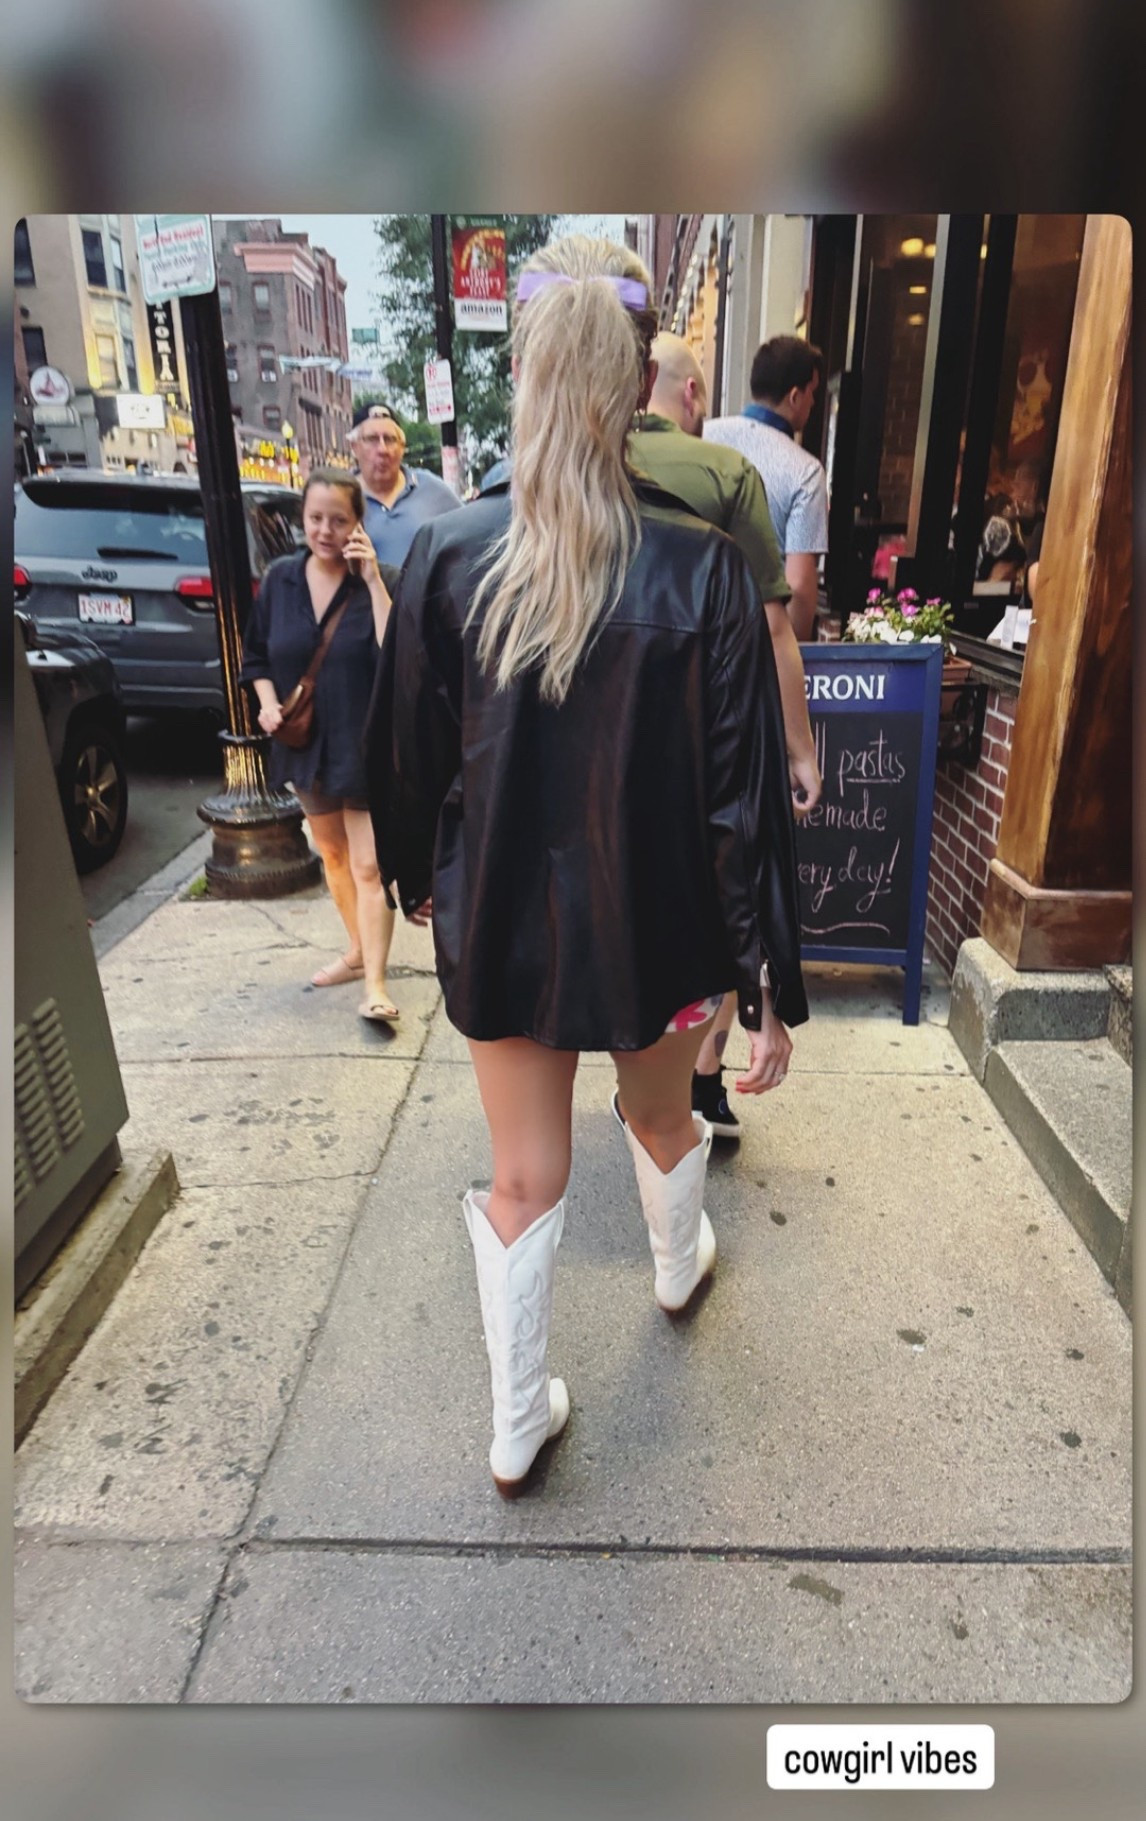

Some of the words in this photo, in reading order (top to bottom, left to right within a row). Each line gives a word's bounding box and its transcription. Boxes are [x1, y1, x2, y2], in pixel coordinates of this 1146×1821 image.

[154, 302, 174, 380] TORIA
[461, 303, 503, 316] amazon
[815, 721, 826, 780] ll
[838, 729, 906, 798] pastas
[797, 863, 834, 913] ery
[838, 838, 901, 913] day!
